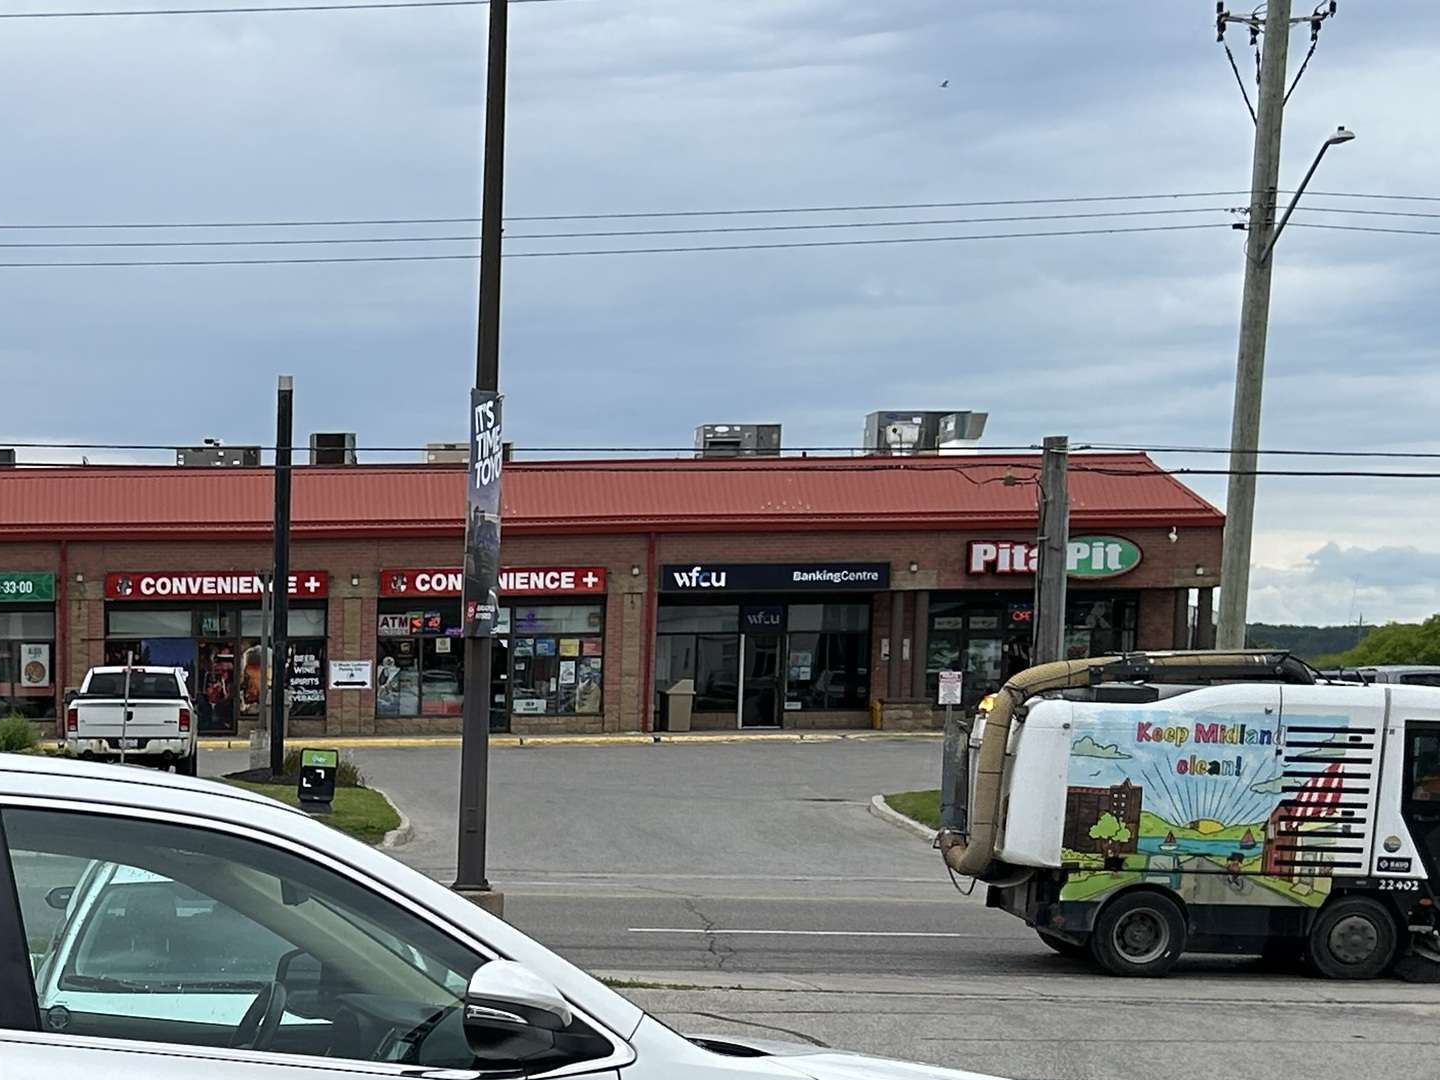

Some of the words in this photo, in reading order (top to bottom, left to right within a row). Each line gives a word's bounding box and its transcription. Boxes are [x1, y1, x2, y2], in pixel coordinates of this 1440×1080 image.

[475, 400, 495, 434] IT'S
[1066, 541, 1123, 571] Pit
[140, 576, 297, 595] CONVENIENE
[415, 571, 575, 592] CONNIENCE
[673, 566, 726, 588] wfcu
[792, 571, 879, 583] BankingCentre
[380, 616, 408, 628] ATM
[1136, 721, 1190, 747] Keep
[1194, 723, 1287, 746] Midland
[1378, 879, 1419, 890] 22402
